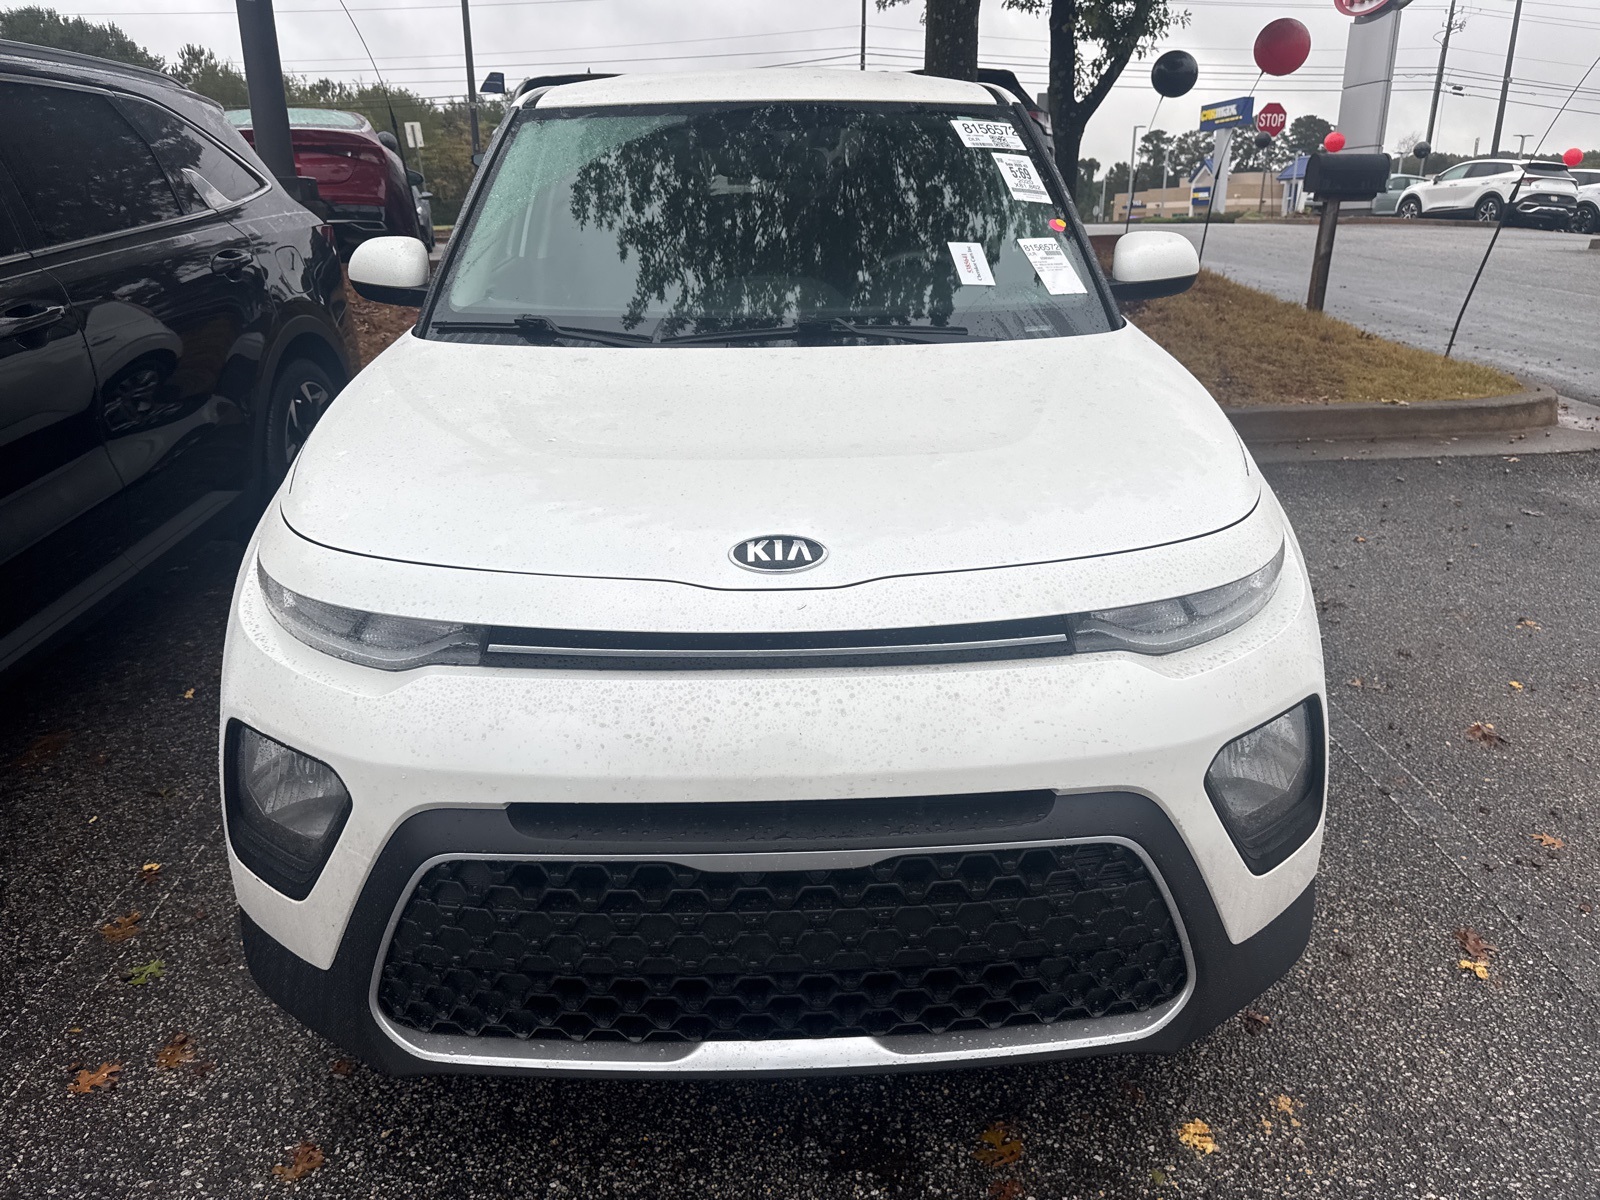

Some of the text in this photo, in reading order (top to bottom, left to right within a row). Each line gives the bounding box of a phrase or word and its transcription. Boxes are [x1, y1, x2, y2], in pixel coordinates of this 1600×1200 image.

[1258, 113, 1285, 127] STOP
[962, 123, 1018, 136] 8156572
[1009, 167, 1031, 180] 5:69
[1023, 243, 1061, 251] 8156572
[745, 539, 813, 562] KIA
